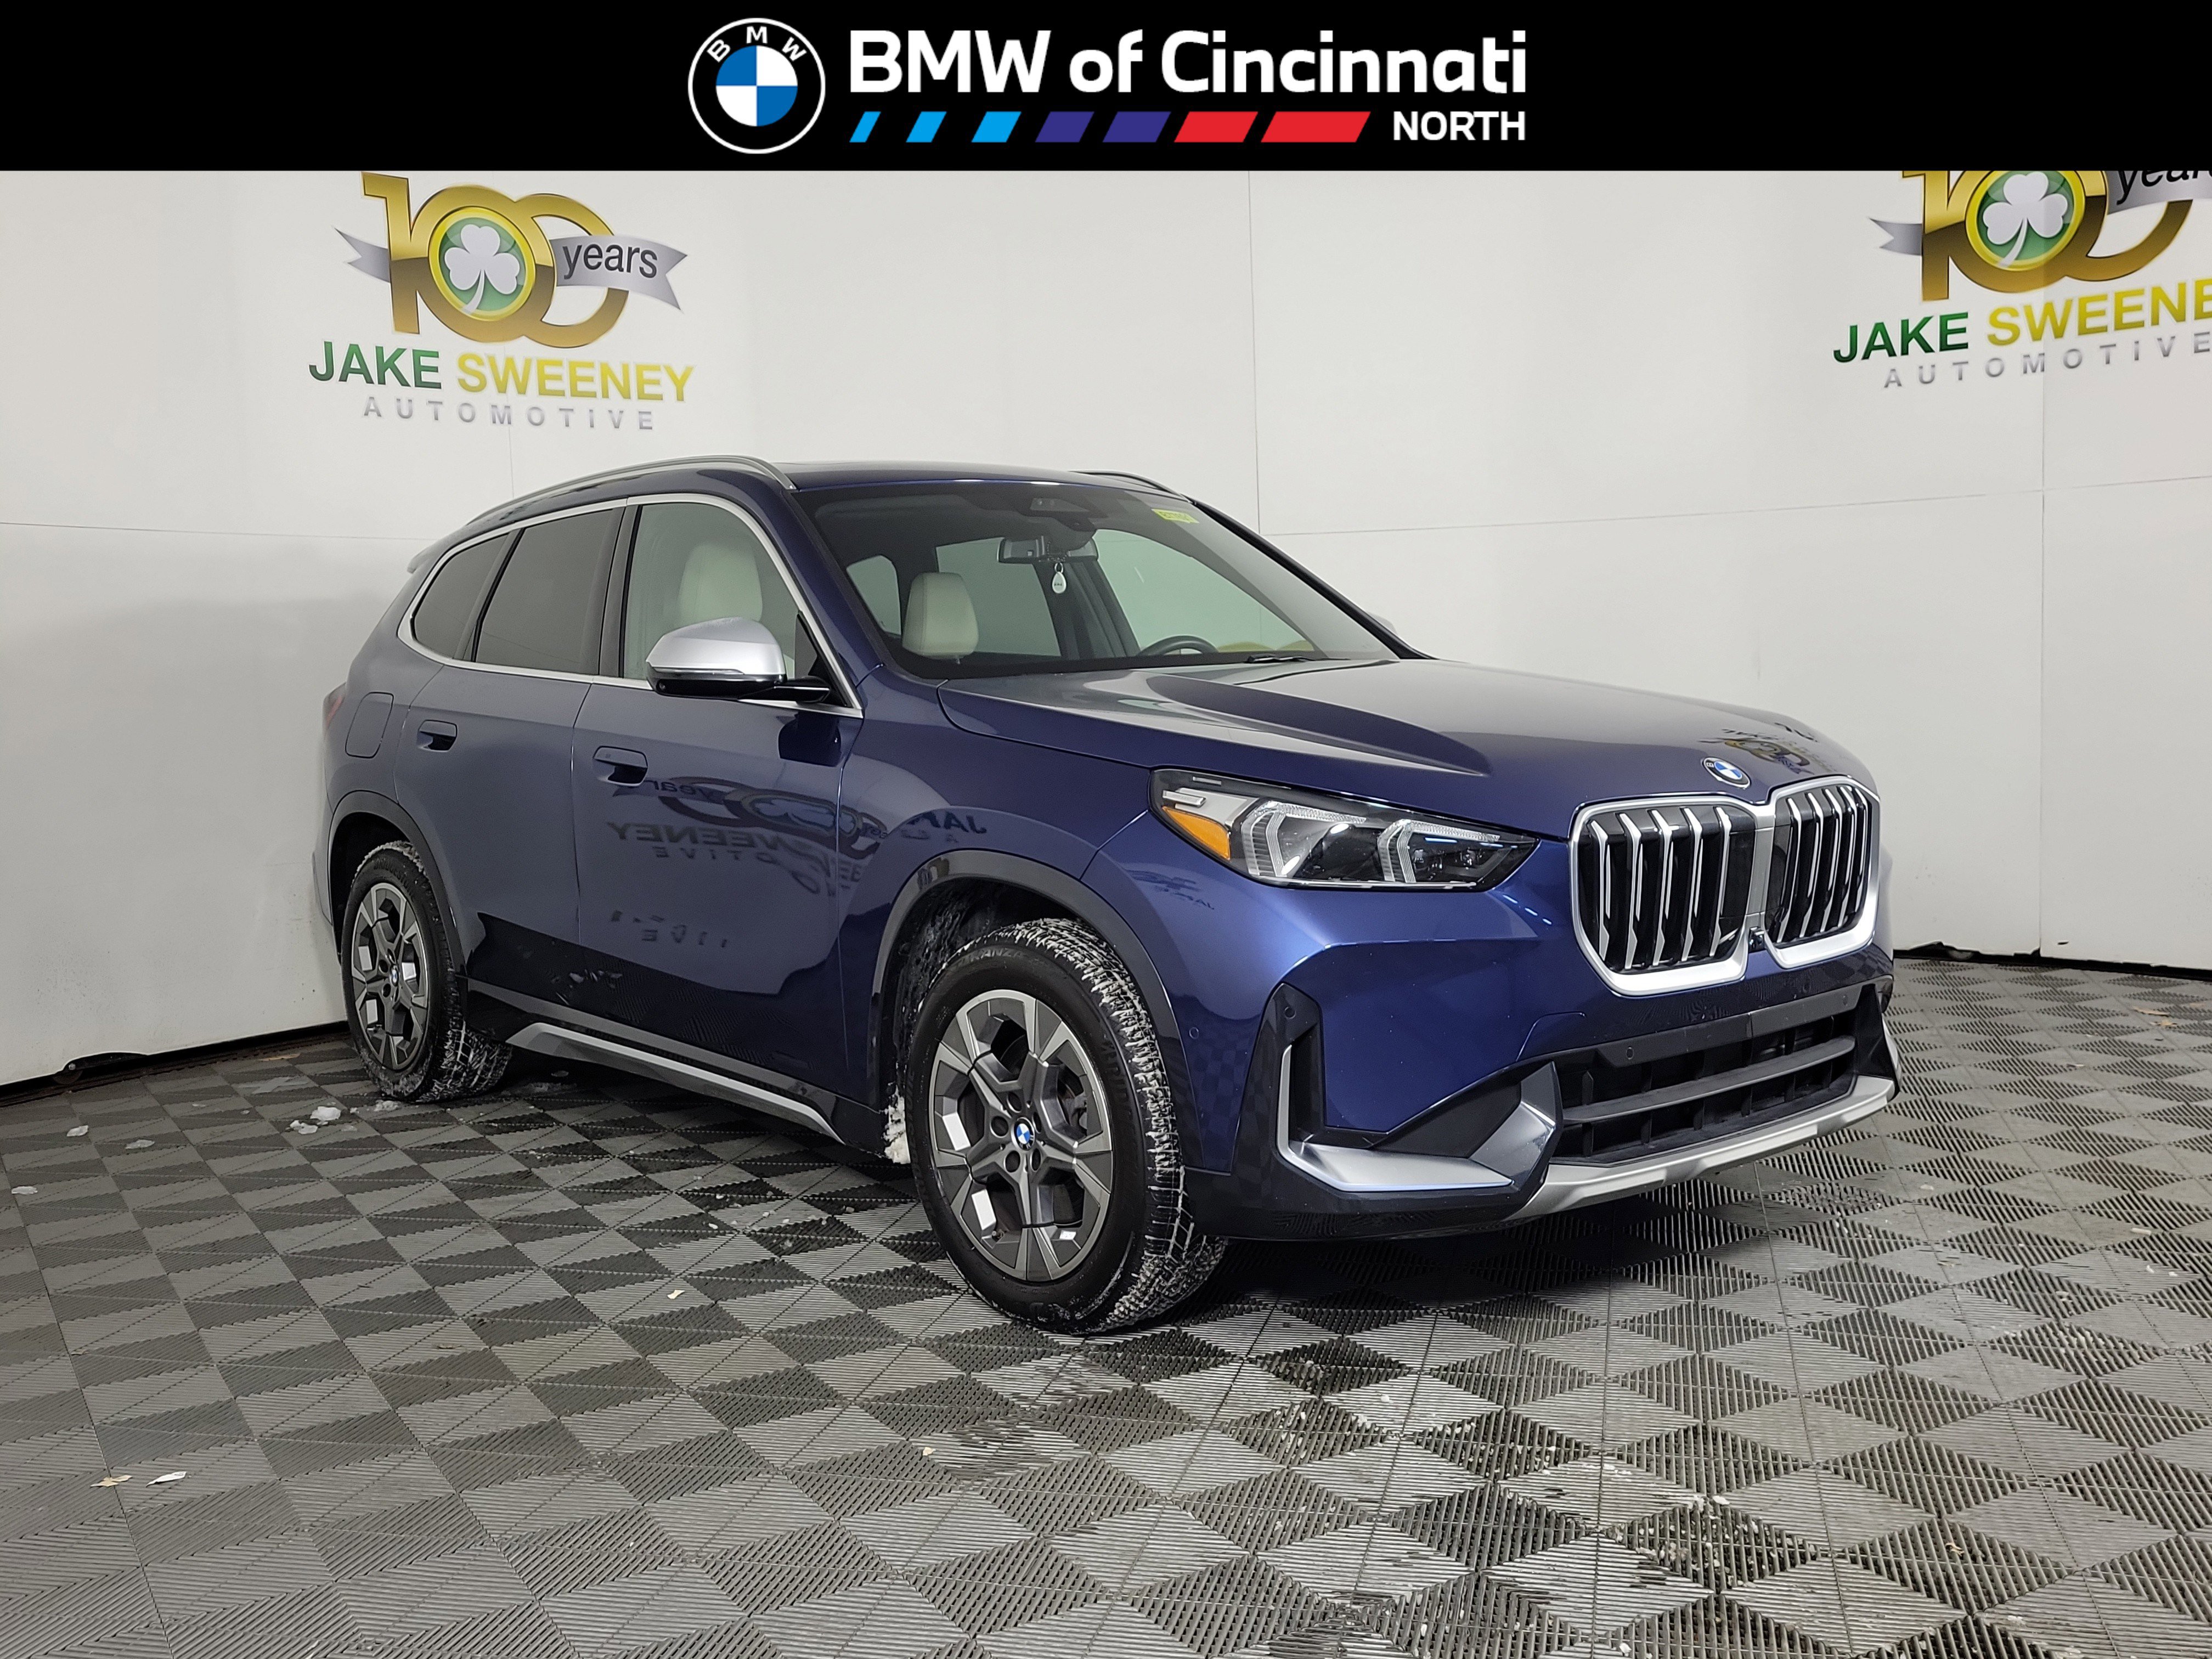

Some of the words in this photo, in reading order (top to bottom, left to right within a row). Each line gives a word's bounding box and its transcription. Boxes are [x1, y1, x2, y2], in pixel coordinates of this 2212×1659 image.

[362, 172, 629, 348] 100
[562, 244, 658, 279] years
[1833, 312, 1969, 363] JAKE
[1987, 278, 2212, 346] SWEENE
[308, 341, 442, 390] JAKE
[458, 353, 694, 402] SWEENEY
[1883, 331, 2210, 388] AUTOMOTIVE
[363, 397, 654, 430] AUTOMOTIVE
